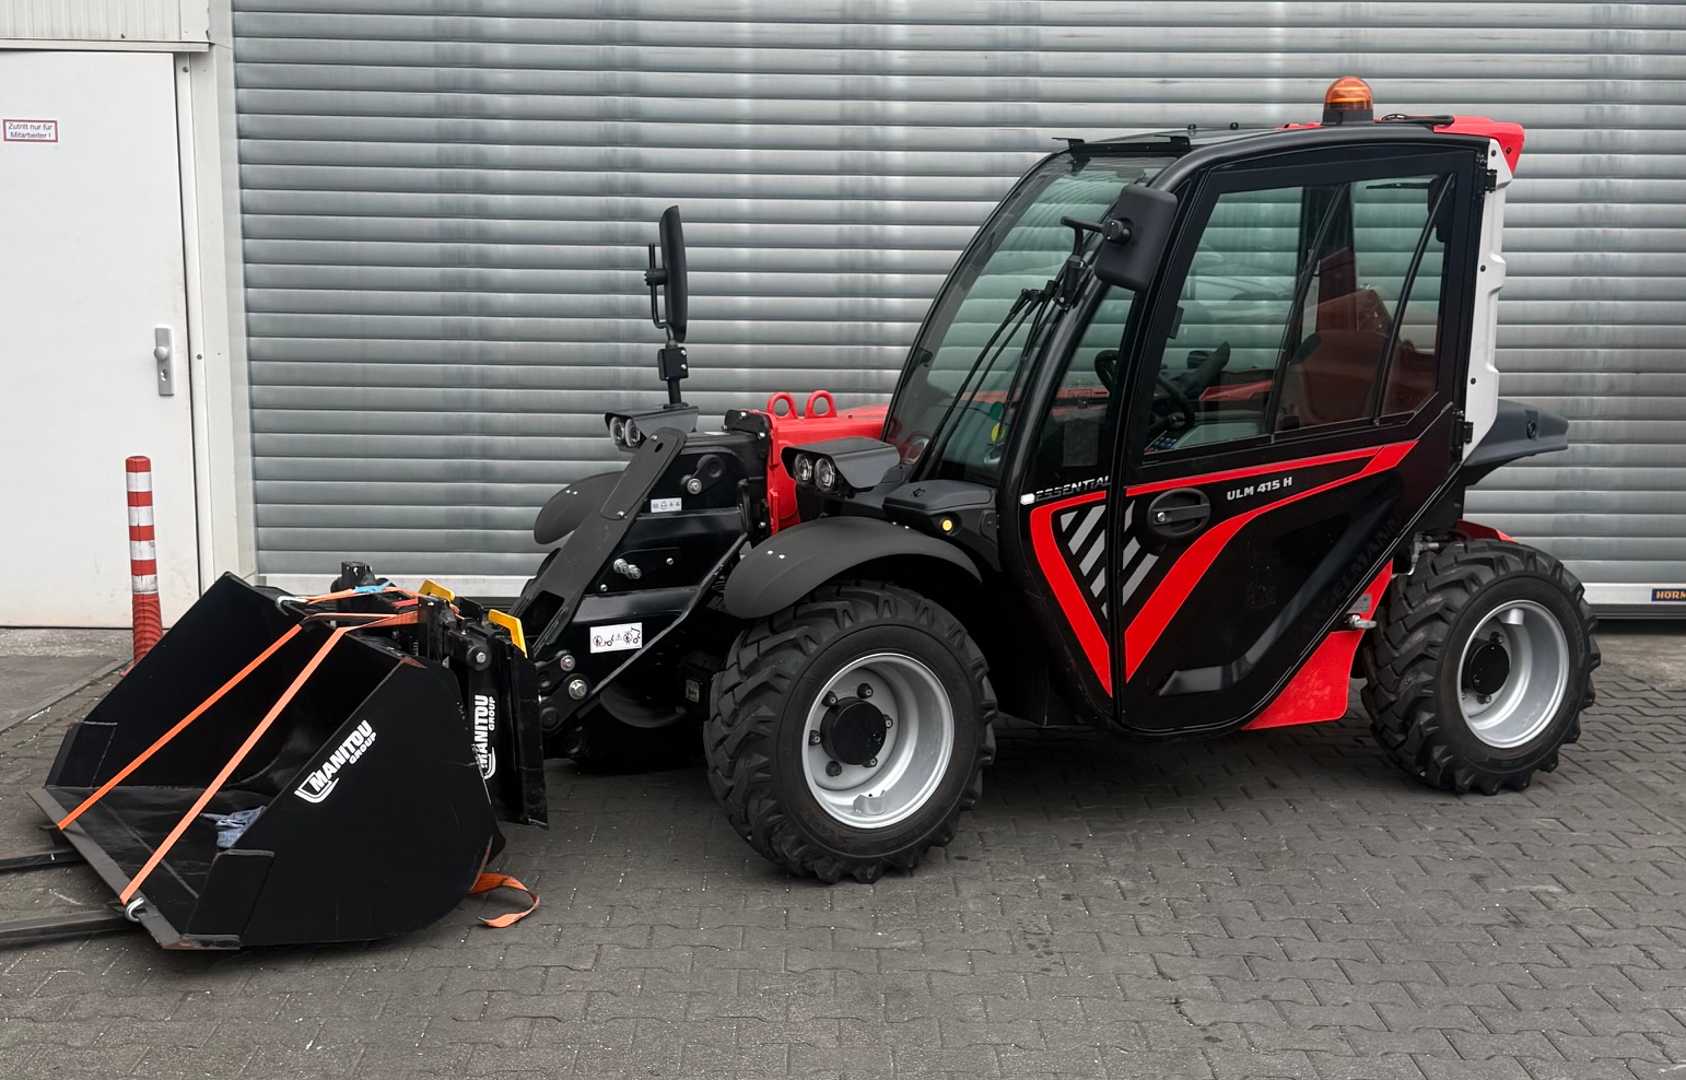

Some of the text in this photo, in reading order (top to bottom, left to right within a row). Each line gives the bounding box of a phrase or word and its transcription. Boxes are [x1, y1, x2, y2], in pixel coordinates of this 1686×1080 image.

[1226, 476, 1292, 500] ULM 415 H
[309, 719, 374, 793] MANITOU
[349, 732, 377, 765] GROUP
